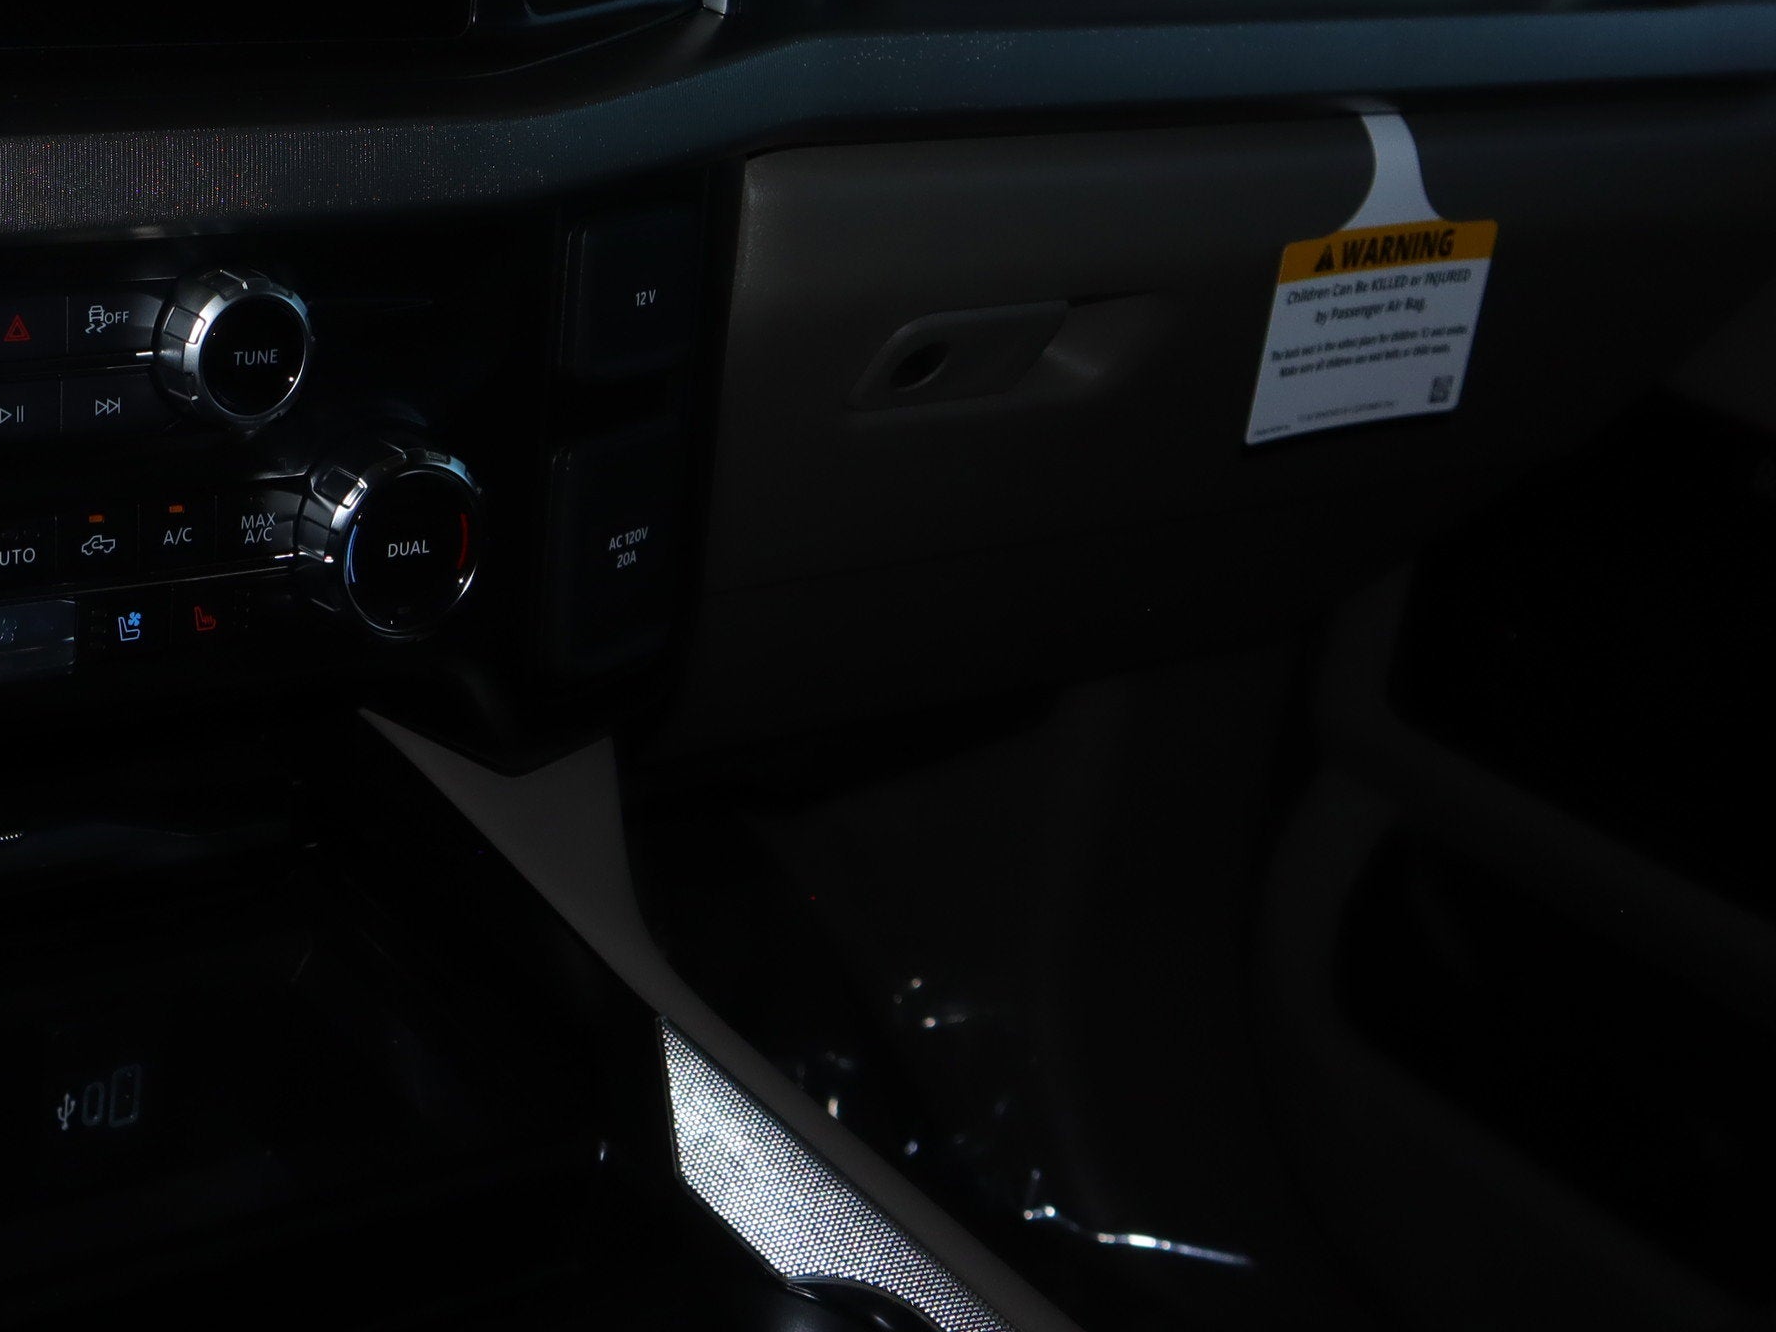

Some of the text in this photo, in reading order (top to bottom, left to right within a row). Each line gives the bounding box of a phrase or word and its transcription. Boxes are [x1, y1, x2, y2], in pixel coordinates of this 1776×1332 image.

[1342, 229, 1456, 269] WARNING
[635, 289, 656, 308] 12V
[1287, 286, 1331, 305] Children
[104, 309, 130, 326] OFF
[233, 348, 280, 366] TUNE
[240, 512, 276, 530] MAX
[163, 527, 192, 546] A/C
[244, 526, 273, 545] A/C
[608, 525, 649, 552] AC 120V
[387, 540, 430, 558] DUAL
[616, 550, 637, 569] 20A
